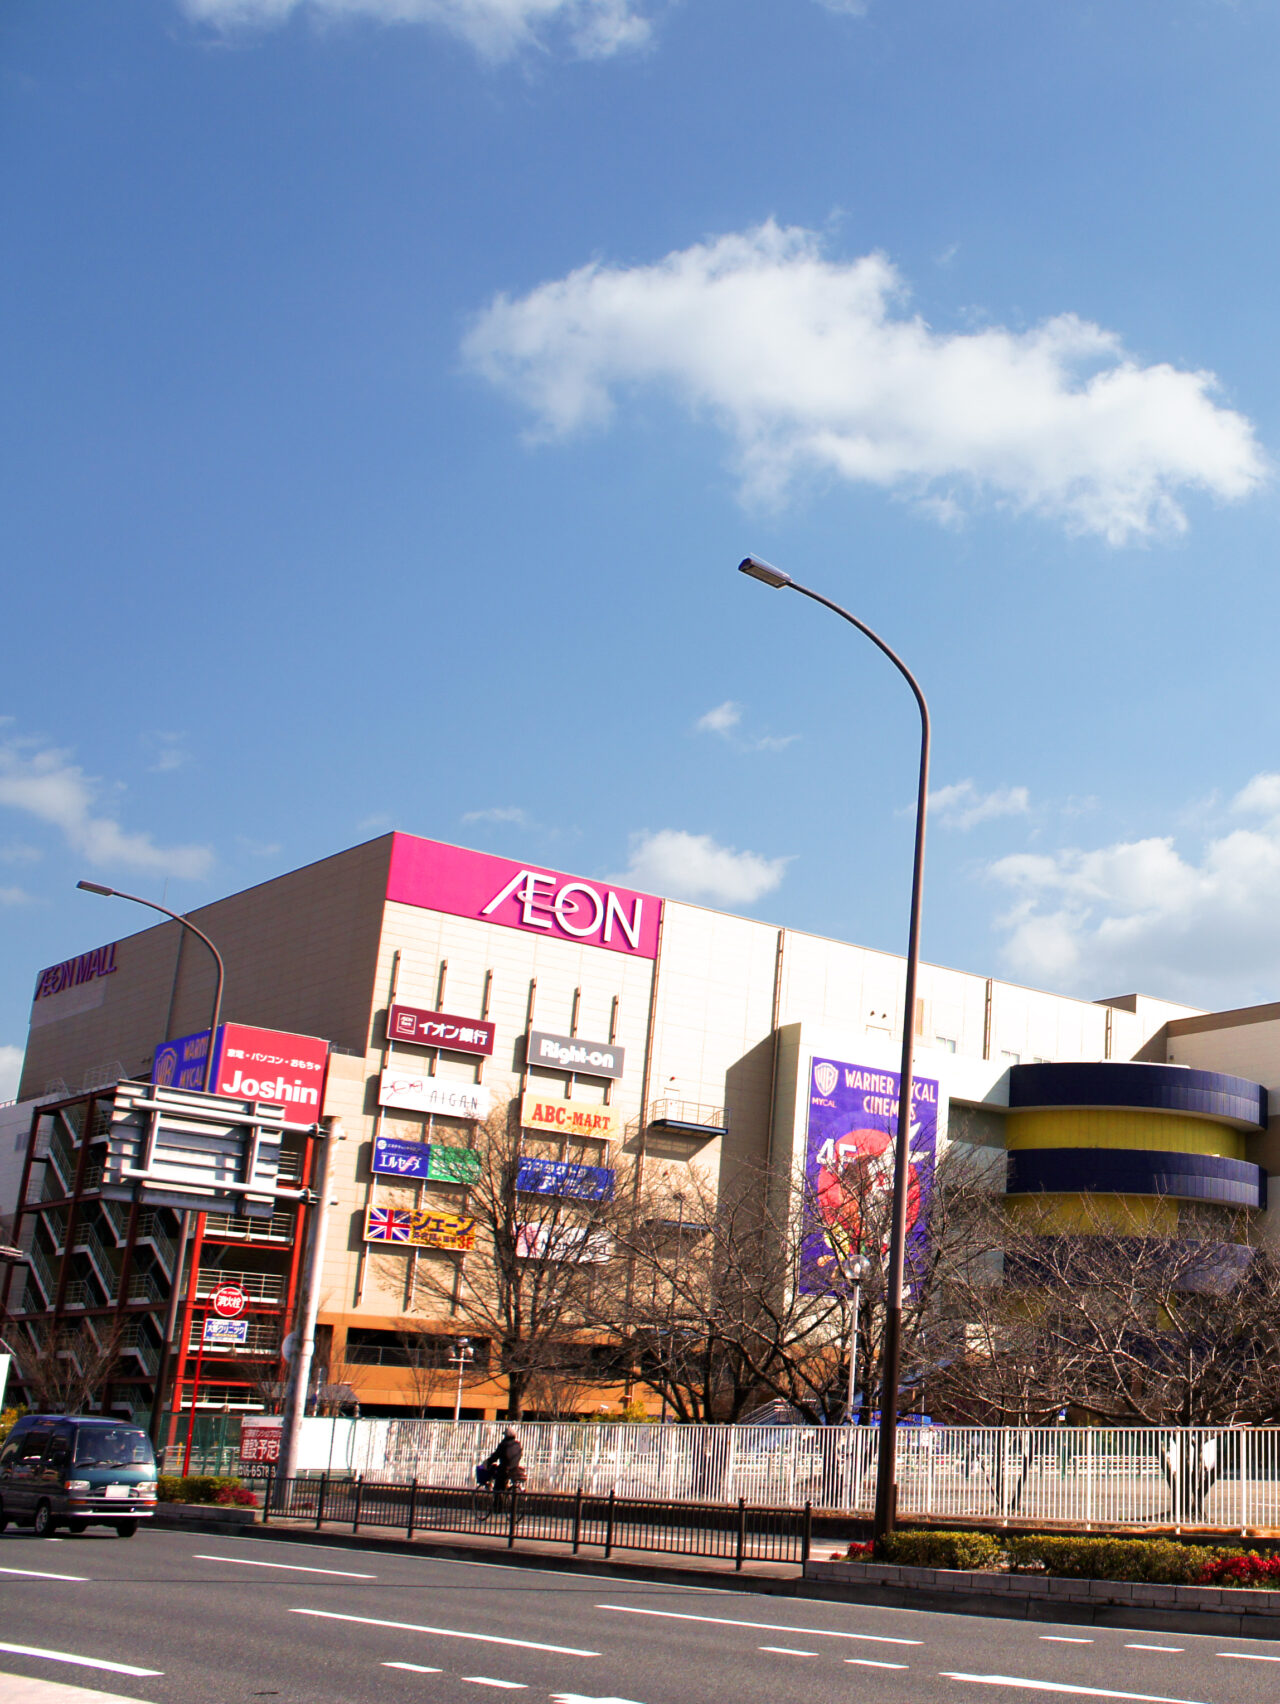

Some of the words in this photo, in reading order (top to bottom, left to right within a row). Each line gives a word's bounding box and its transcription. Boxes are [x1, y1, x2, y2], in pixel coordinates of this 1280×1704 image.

[75, 942, 117, 985] MALL
[419, 1021, 488, 1046] イオン銀行
[183, 1035, 209, 1062] WARN
[540, 1039, 614, 1068] Right-on
[222, 1070, 318, 1105] Joshin
[844, 1068, 894, 1096] WARNER
[898, 1078, 936, 1103] YCAL
[531, 1103, 611, 1130] ABC-MART
[812, 1097, 837, 1109] MYCAL
[863, 1095, 917, 1121] CINEMS
[816, 1138, 857, 1174] 4F
[413, 1211, 475, 1235] シェーン
[217, 1296, 241, 1308] 消火栓
[242, 1439, 280, 1460] 建設予定
